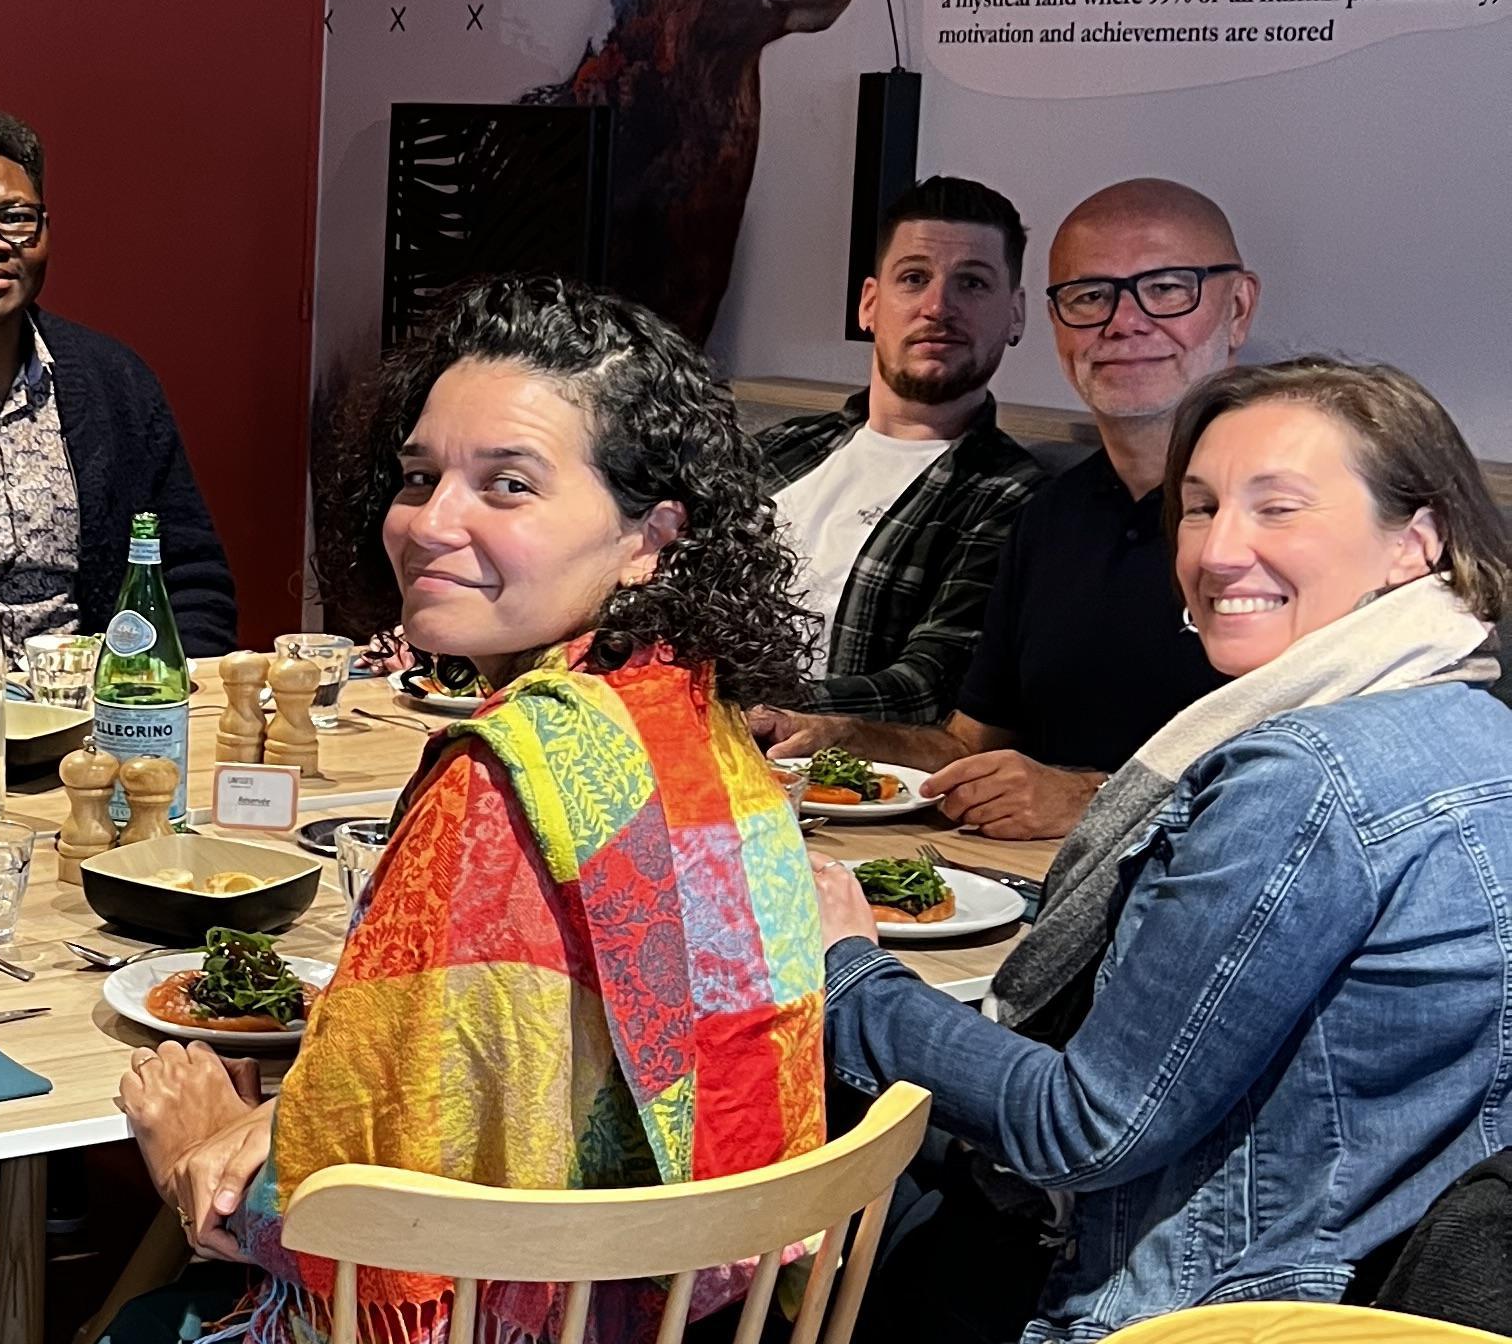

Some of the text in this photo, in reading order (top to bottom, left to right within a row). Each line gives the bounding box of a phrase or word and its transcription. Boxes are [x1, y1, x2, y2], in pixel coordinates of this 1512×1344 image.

[938, 19, 1335, 43] motivation and achievements are stored
[95, 719, 173, 738] ELLEGRINO
